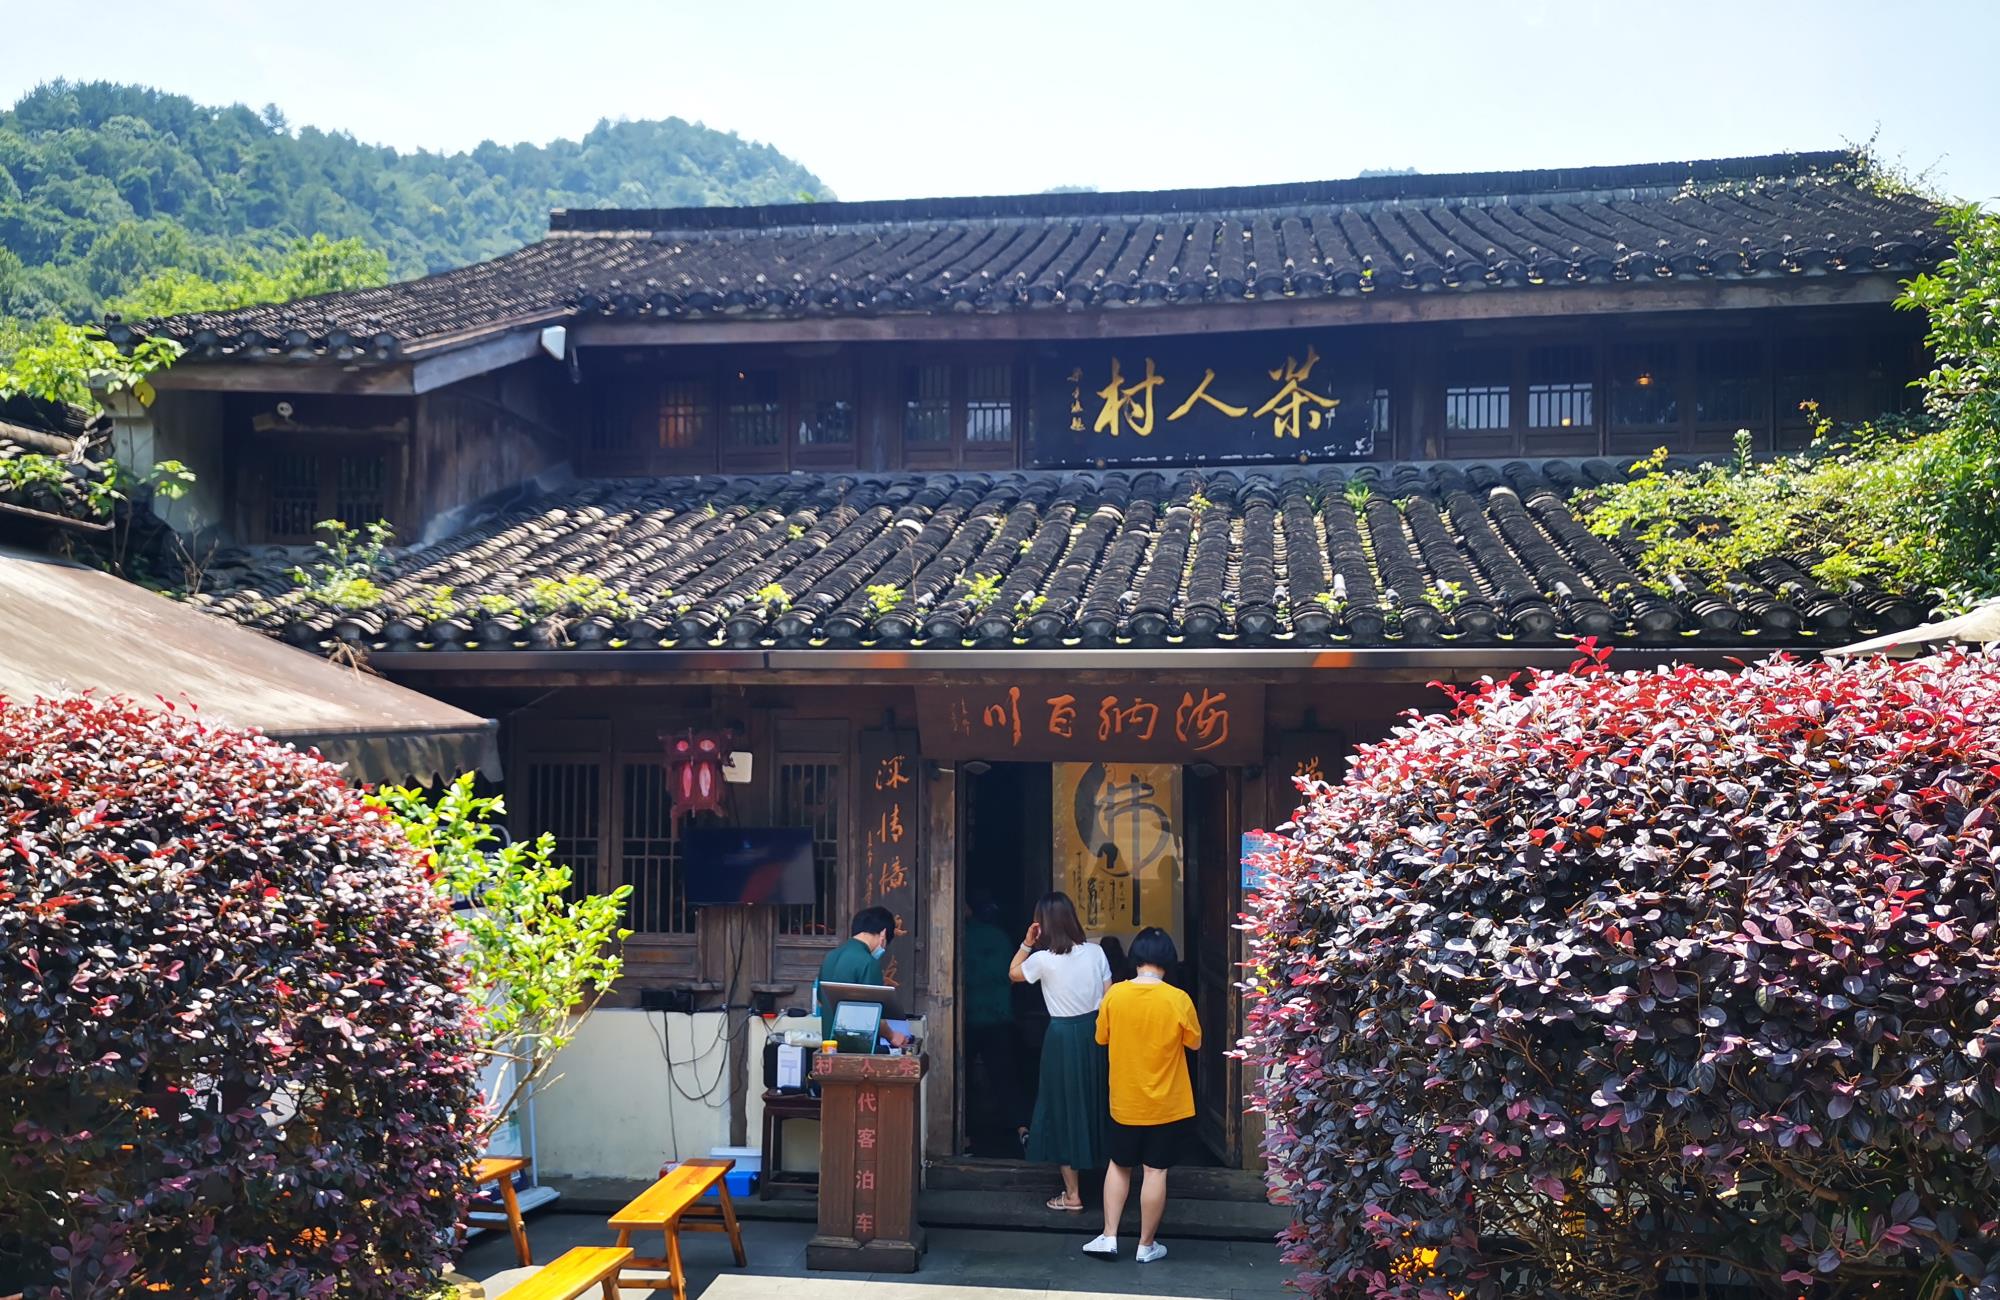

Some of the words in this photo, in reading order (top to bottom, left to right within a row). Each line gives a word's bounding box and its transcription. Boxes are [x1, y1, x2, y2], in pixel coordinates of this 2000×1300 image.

[1094, 344, 1340, 438] 茶人村
[856, 1092, 876, 1233] 代客泊车
